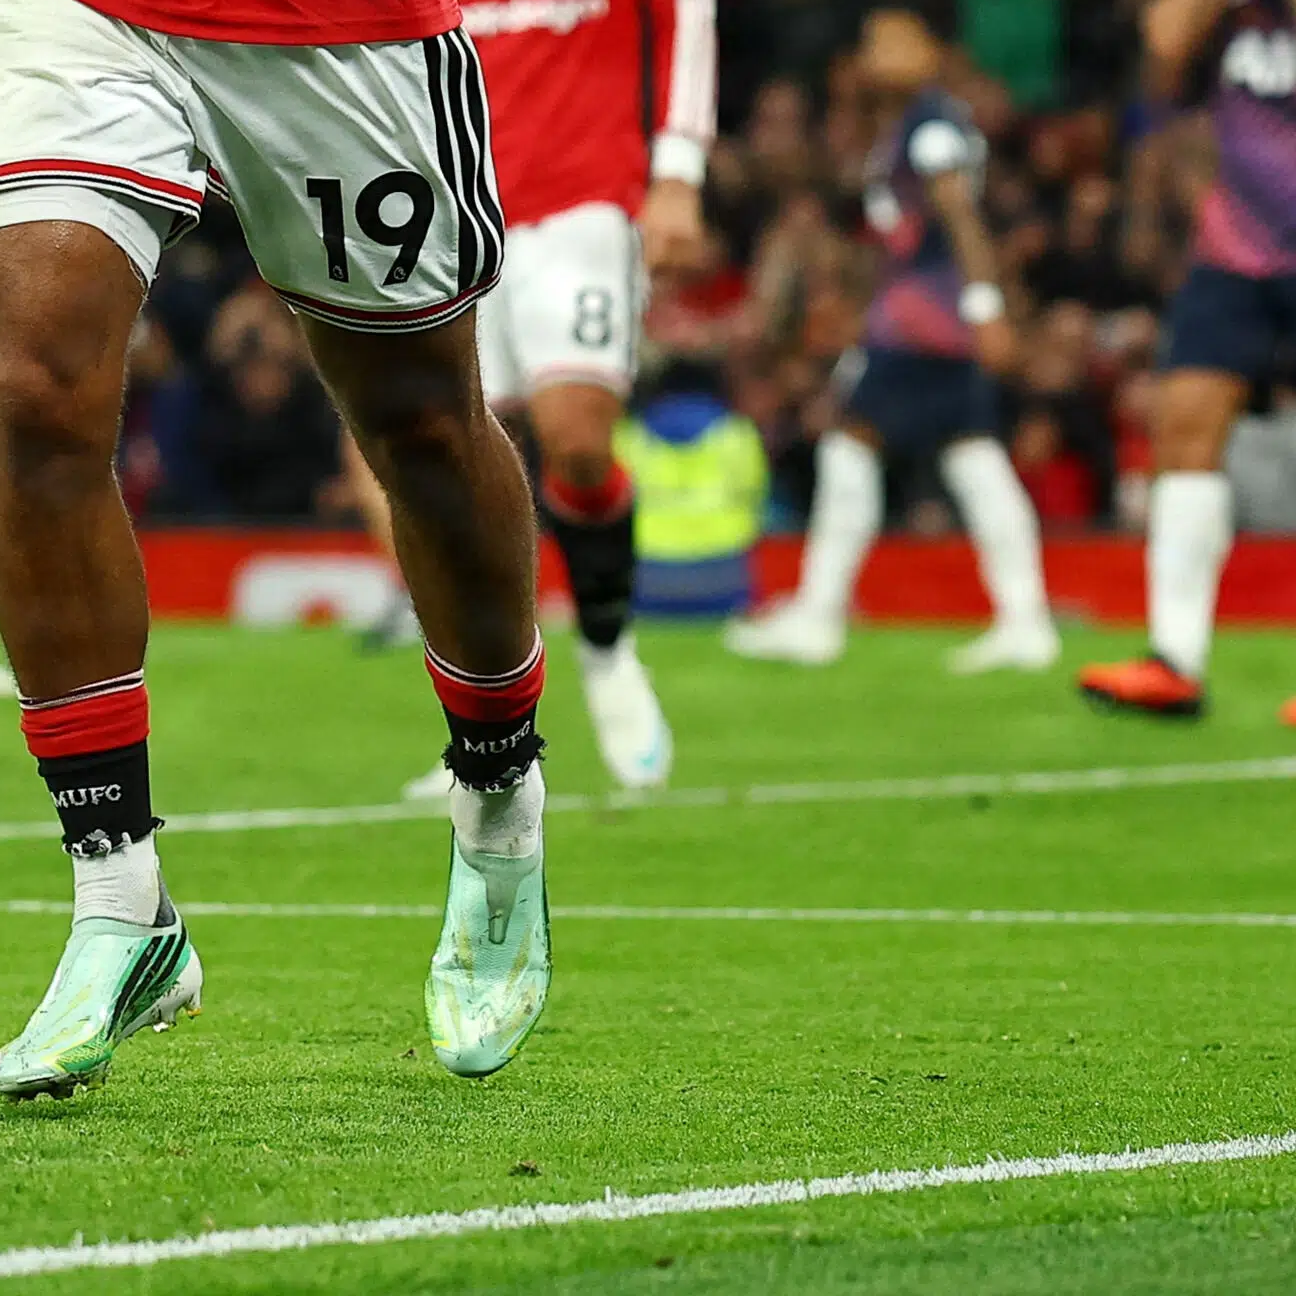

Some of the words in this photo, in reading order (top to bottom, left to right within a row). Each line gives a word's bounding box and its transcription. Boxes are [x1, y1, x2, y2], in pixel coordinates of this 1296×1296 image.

[306, 170, 435, 286] 19
[570, 286, 613, 350] 8
[55, 784, 122, 808] MUFC
